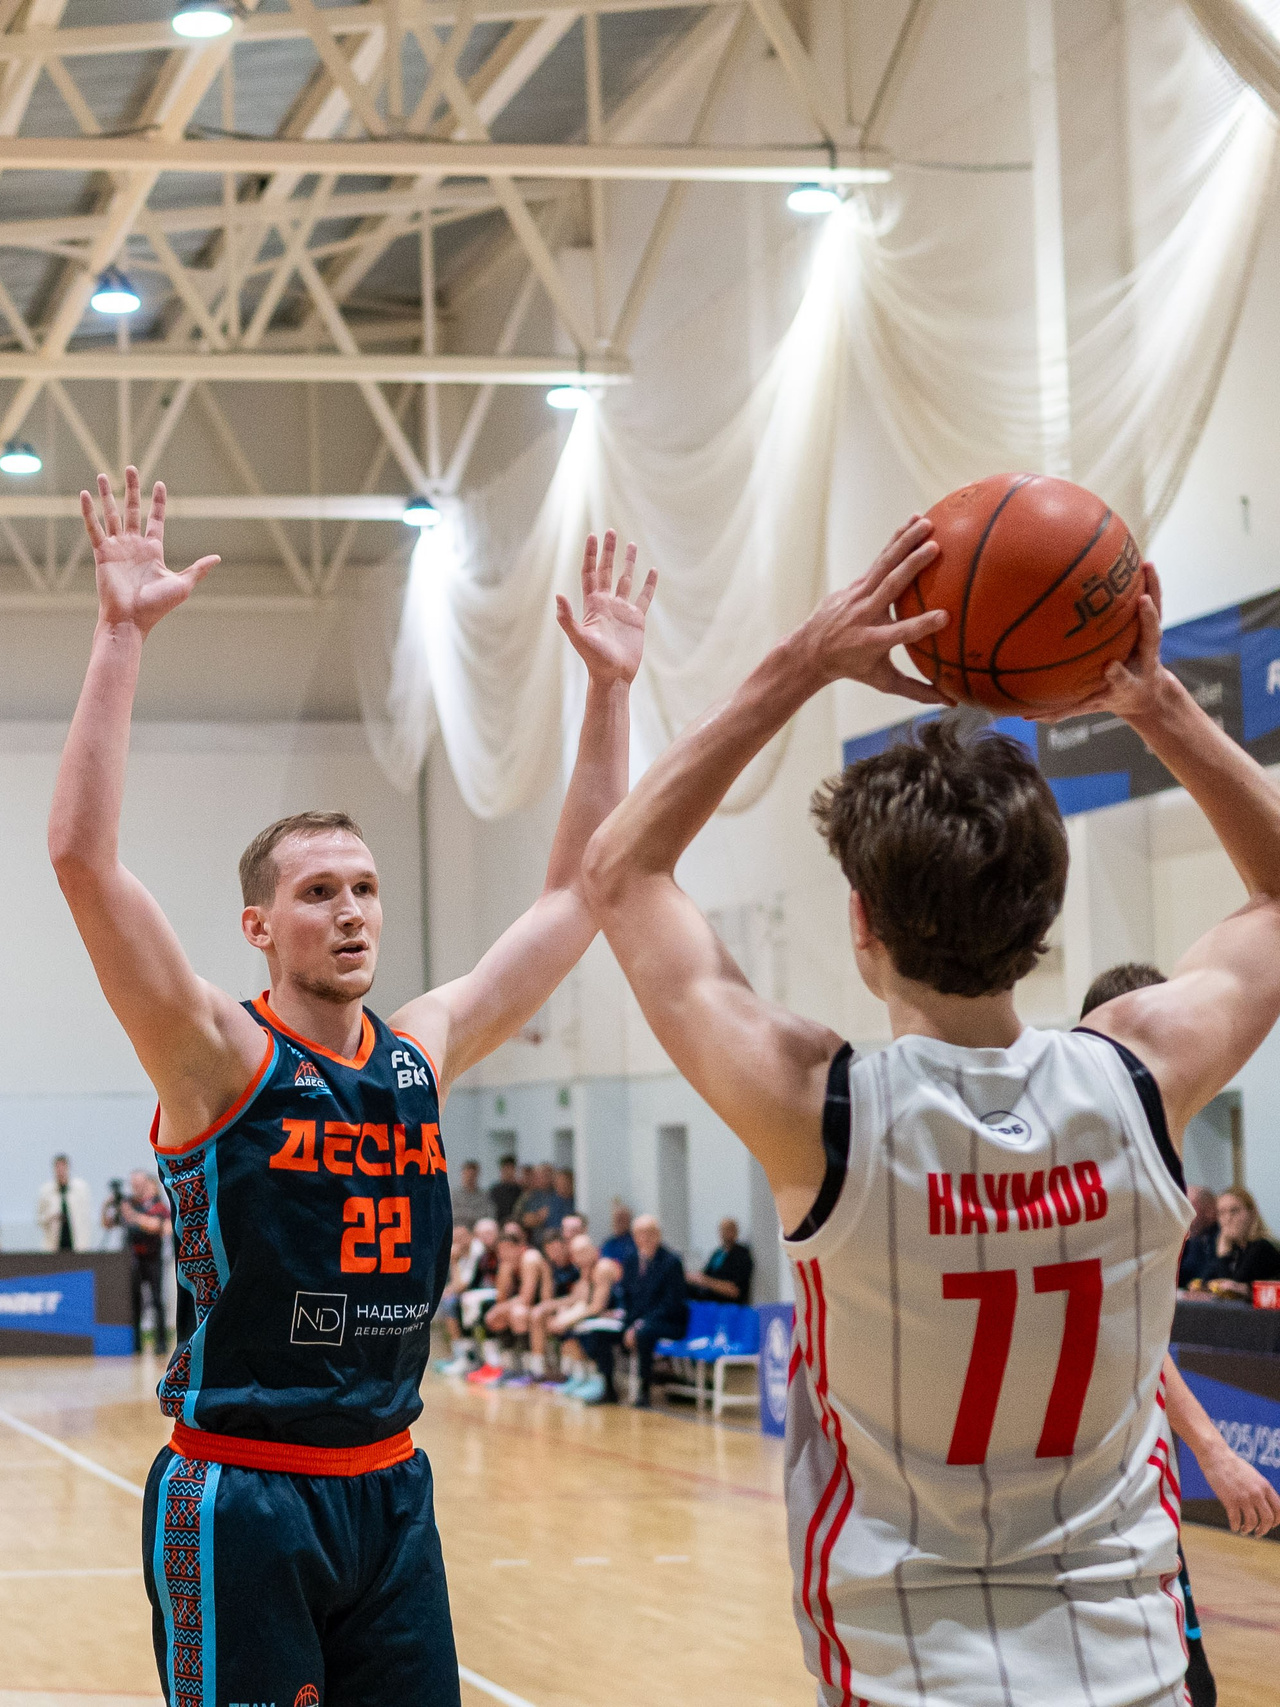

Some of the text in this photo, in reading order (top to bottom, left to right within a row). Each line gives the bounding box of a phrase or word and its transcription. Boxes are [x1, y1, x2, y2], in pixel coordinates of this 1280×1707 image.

[269, 1118, 447, 1177] ДЕСНА
[340, 1196, 412, 1274] 22
[927, 1160, 1109, 1235] НАУМОВ
[356, 1302, 429, 1322] НАДЕЖДА
[941, 1257, 1104, 1466] 77
